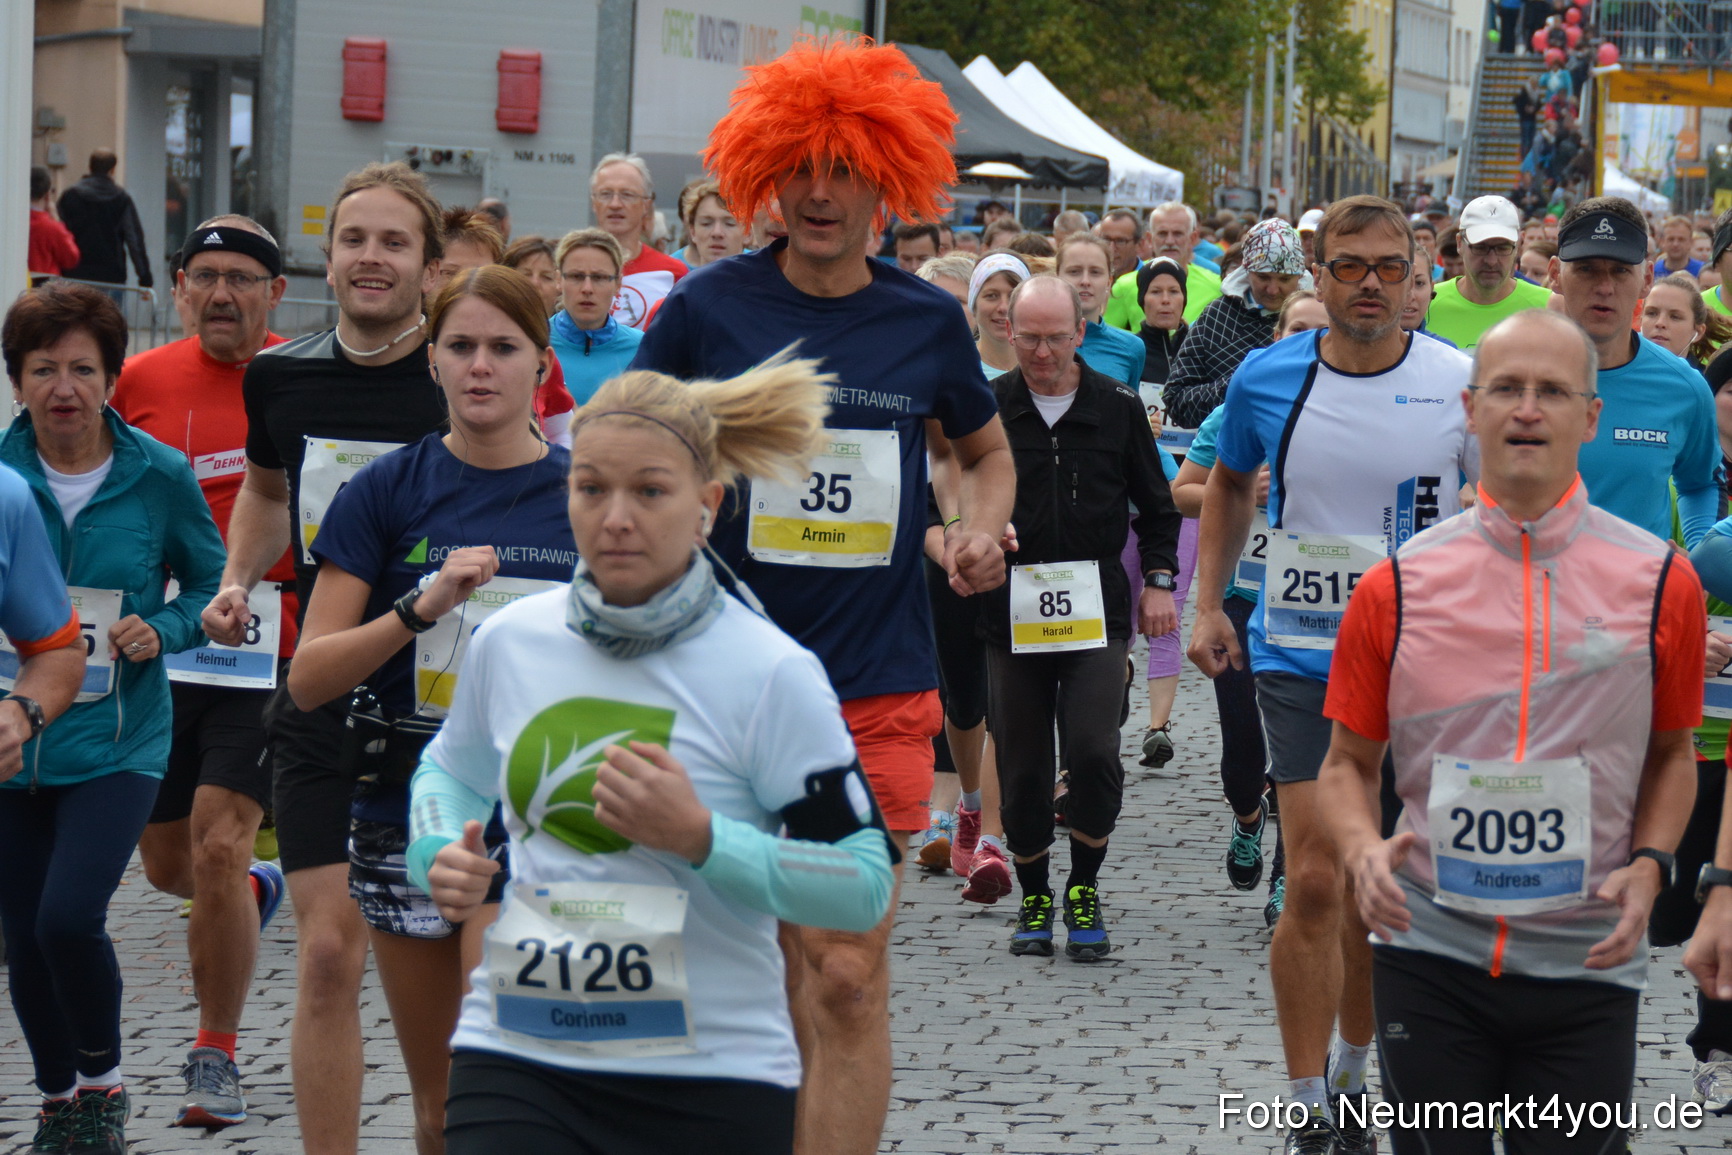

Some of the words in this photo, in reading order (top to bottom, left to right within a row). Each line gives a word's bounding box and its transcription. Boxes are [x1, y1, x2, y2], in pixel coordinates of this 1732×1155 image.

[825, 387, 912, 413] METRAWATT
[1158, 433, 1178, 442] tefani
[1613, 427, 1669, 444] BOCK
[213, 455, 246, 470] DEHN
[800, 472, 852, 514] 35
[306, 511, 312, 519] D
[802, 527, 846, 543] Armin
[1308, 545, 1350, 556] BOCK
[1042, 570, 1074, 580] BOCK
[1039, 590, 1073, 617] 85
[1299, 615, 1342, 630] Matthia
[1042, 626, 1073, 636] Harald
[195, 652, 238, 667] Helmut
[424, 654, 430, 662] D
[1486, 776, 1544, 789] BOCK
[1450, 807, 1565, 855] 2093
[1473, 870, 1541, 888] Andreas
[563, 901, 625, 916] BOCK
[516, 938, 653, 992] 2126
[551, 1007, 627, 1028] Corinna
